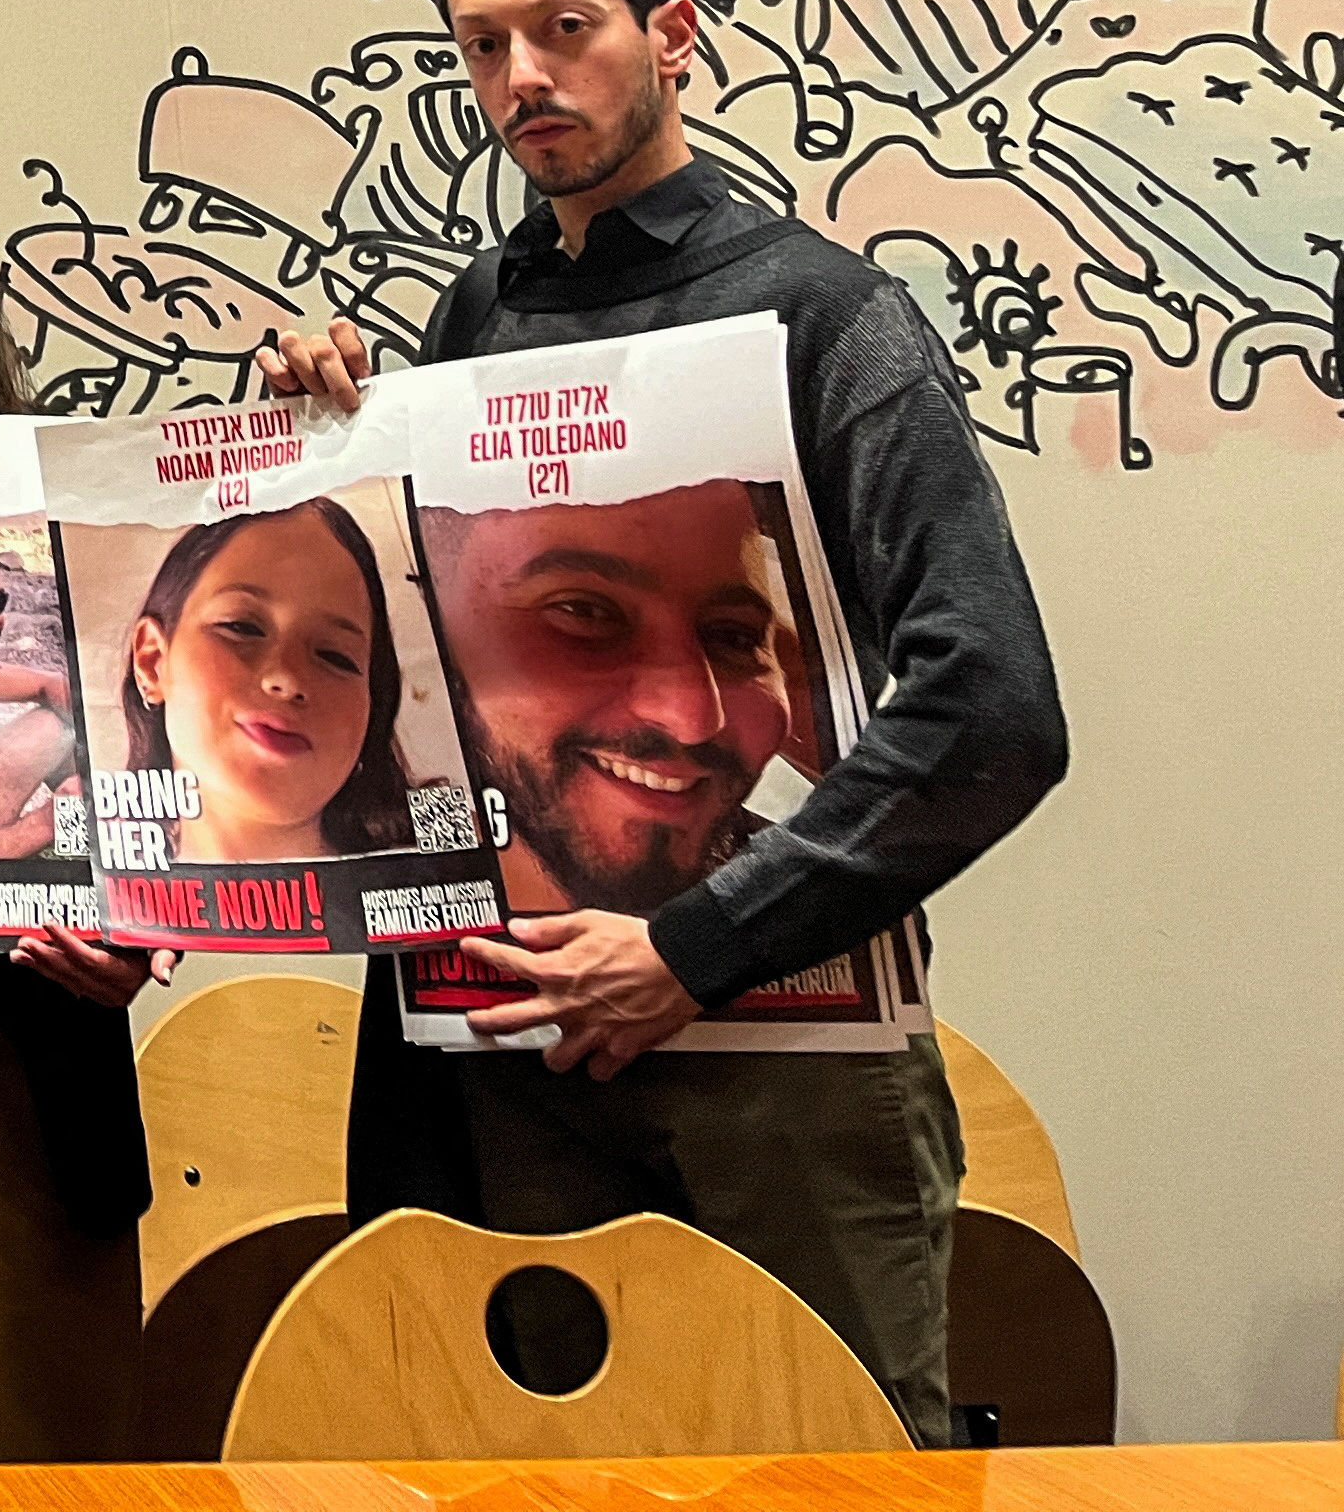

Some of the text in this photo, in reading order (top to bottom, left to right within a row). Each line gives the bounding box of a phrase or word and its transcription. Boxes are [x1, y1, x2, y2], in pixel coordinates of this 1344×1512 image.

[557, 384, 609, 417] אליה
[470, 419, 626, 462] ELIA TOLEDANO
[156, 439, 303, 484] NOAM AVIGDORI
[528, 459, 570, 498] (27)
[218, 477, 250, 511] (12)
[93, 768, 200, 820] BRING
[99, 820, 170, 872] HER
[105, 870, 324, 931] HOME NOW!
[361, 880, 494, 910] HOSTAGES AND MISSING
[67, 902, 102, 931] FOR
[365, 899, 500, 937] FAMILIES FORUM
